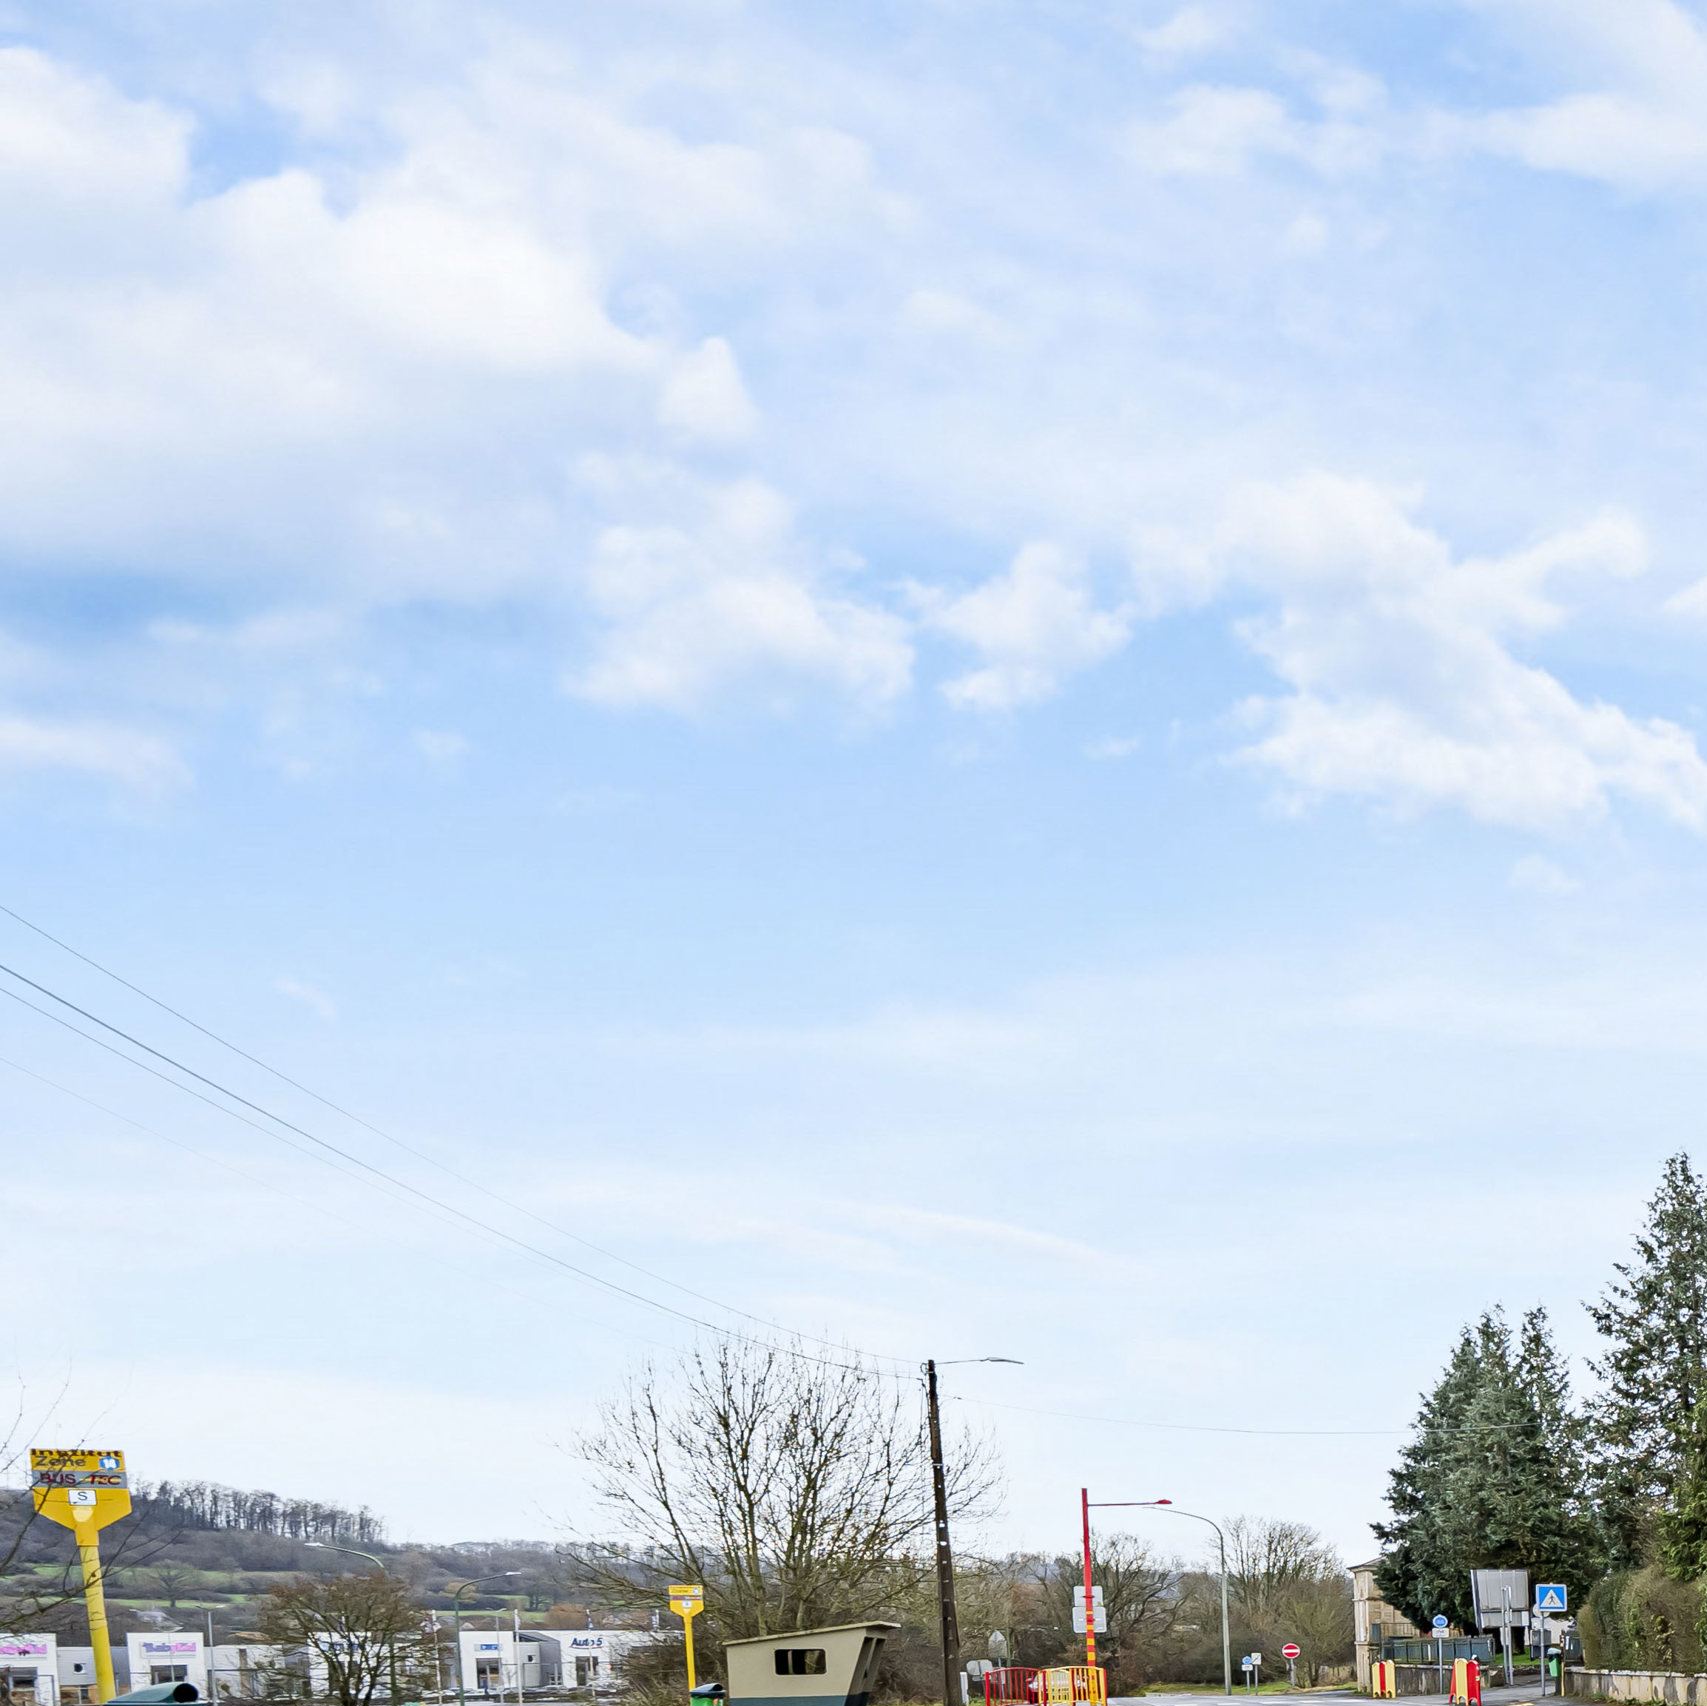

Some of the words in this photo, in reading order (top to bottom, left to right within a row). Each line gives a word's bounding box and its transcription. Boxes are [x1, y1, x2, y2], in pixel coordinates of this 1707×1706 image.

[36, 1455, 86, 1467] Zone
[40, 1472, 76, 1486] BUS
[90, 1474, 121, 1486] TEC
[77, 1491, 88, 1501] S
[570, 1637, 595, 1647] Auto
[595, 1637, 604, 1646] 5
